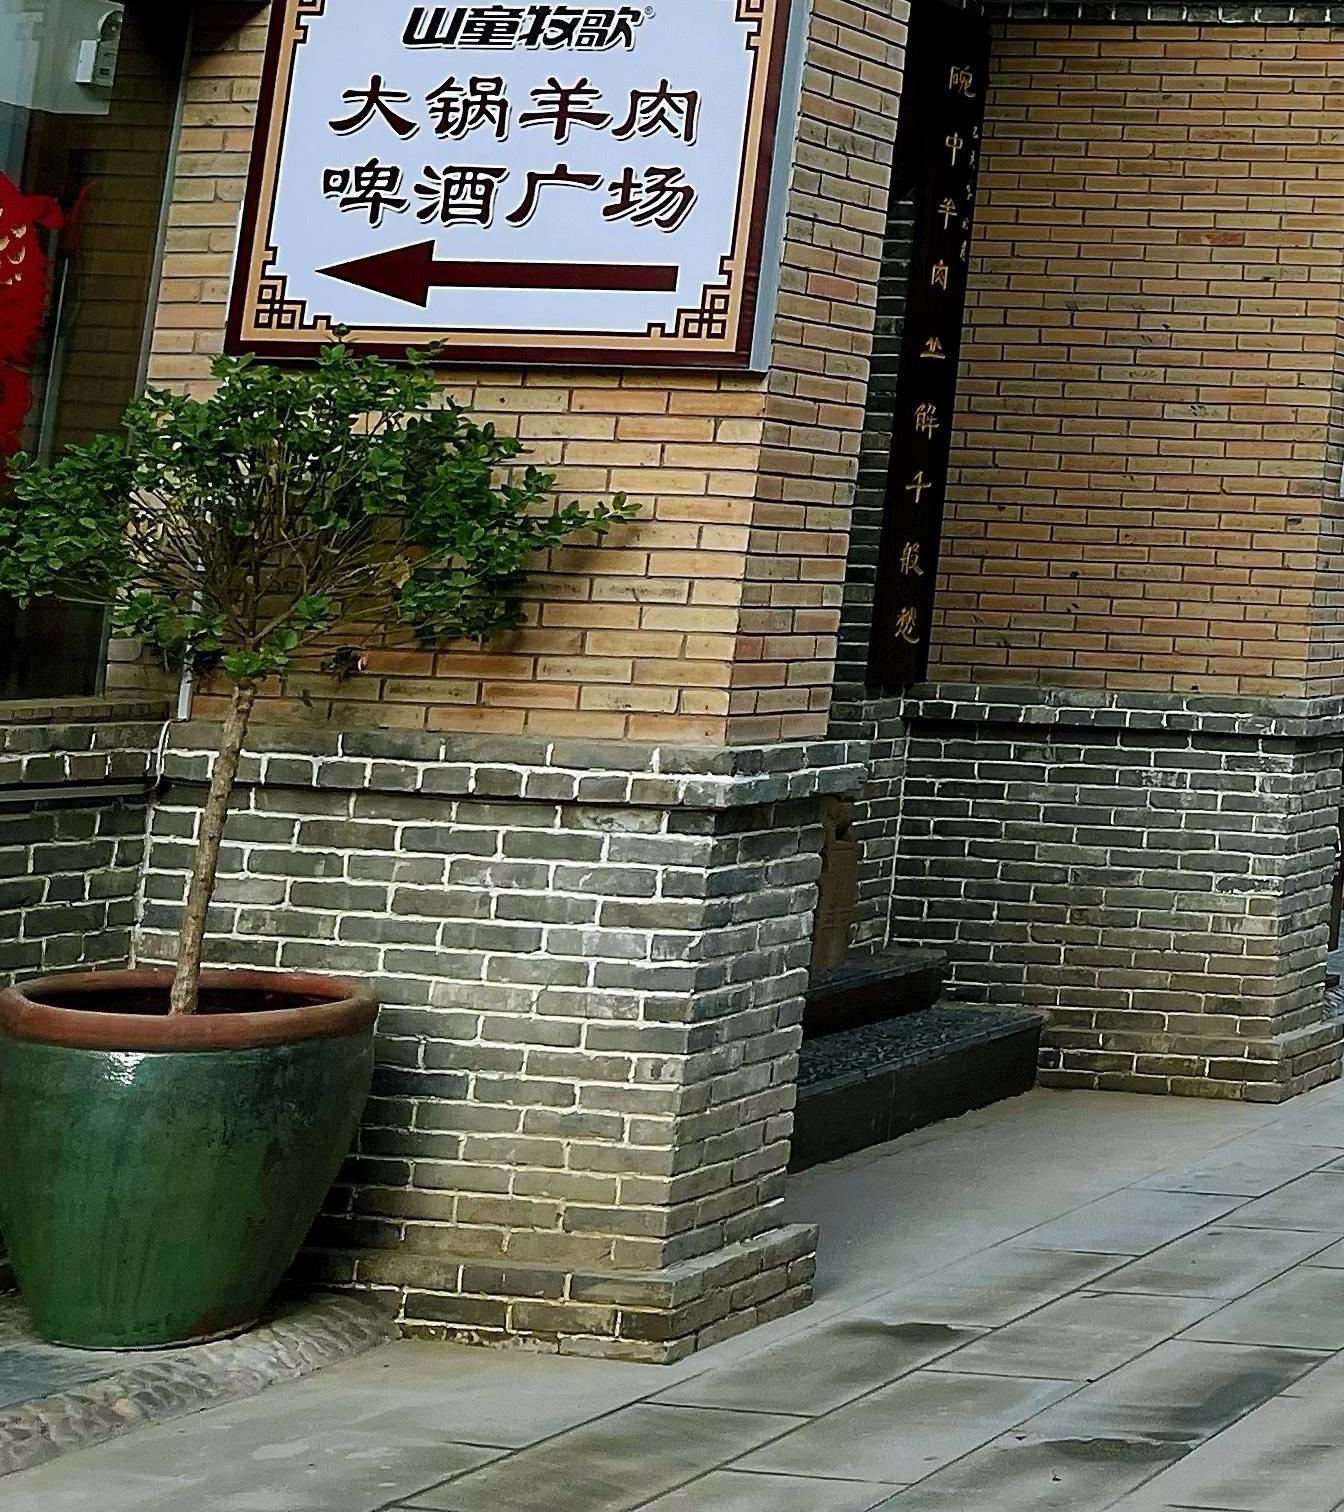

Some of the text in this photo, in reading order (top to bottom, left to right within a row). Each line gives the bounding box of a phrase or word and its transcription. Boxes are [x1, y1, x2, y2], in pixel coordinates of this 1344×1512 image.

[401, 4, 644, 51] 山童牧歌
[328, 74, 700, 145] 大锅羊肉
[321, 157, 698, 231] 啤酒广场
